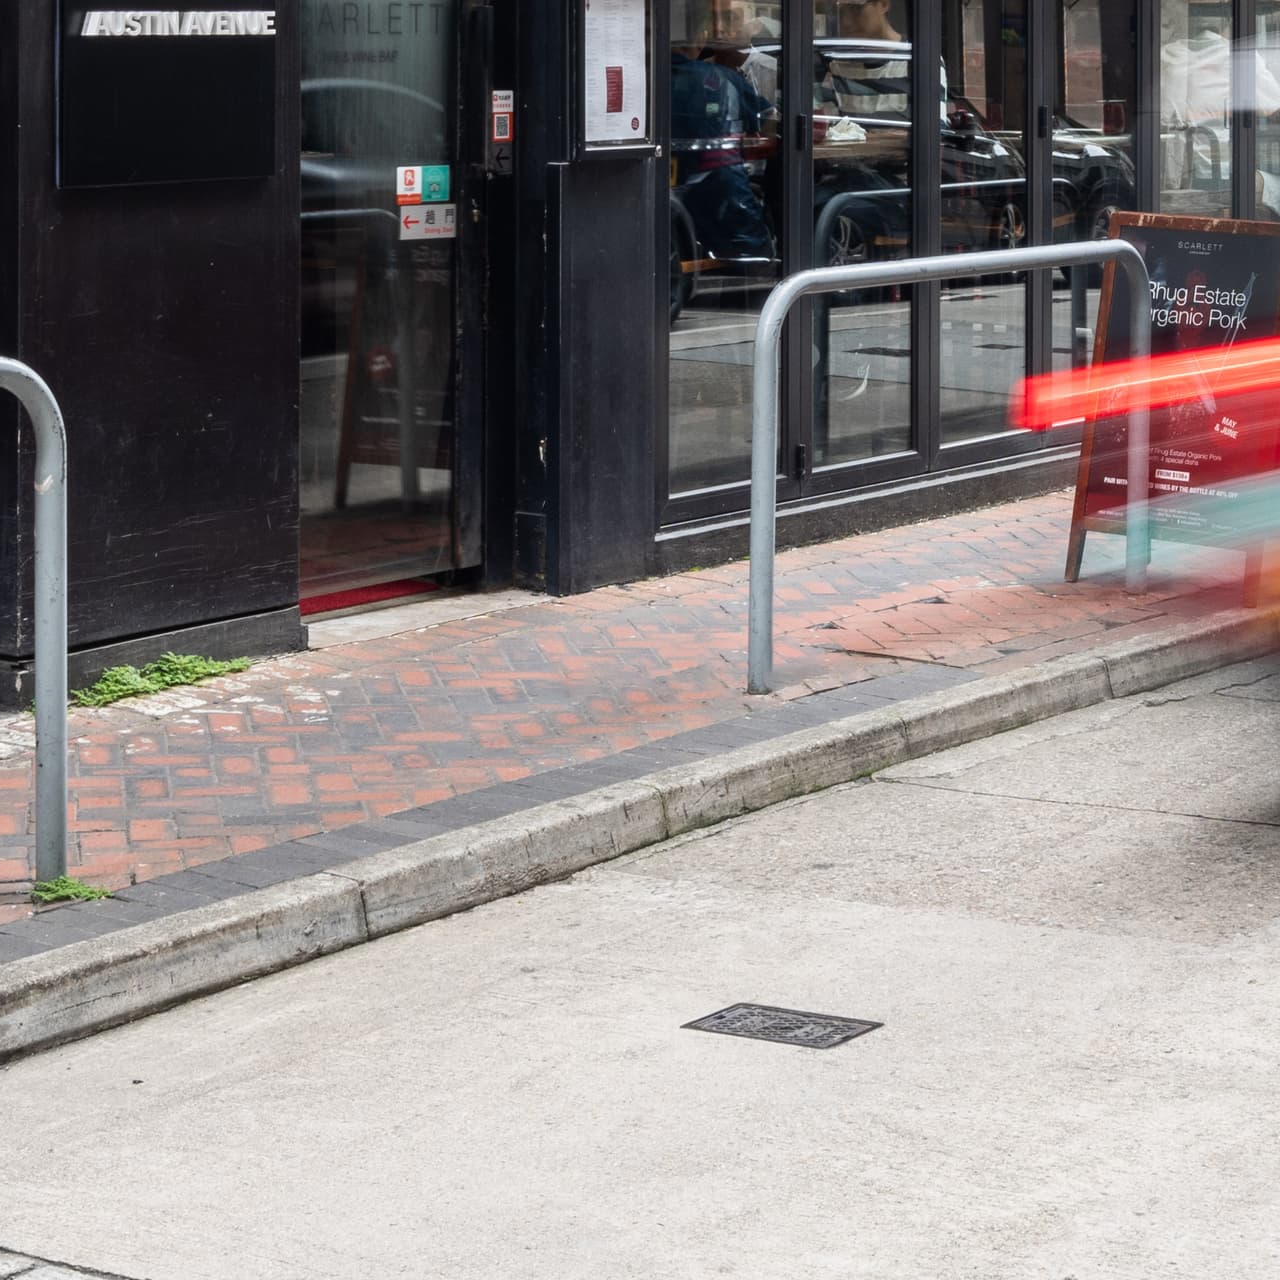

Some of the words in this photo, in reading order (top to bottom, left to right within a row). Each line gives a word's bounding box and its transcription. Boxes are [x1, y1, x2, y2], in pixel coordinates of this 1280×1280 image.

[81, 10, 180, 36] AUSTIN
[180, 10, 276, 35] AVENUE
[302, 1, 445, 35] ARLETT
[1178, 241, 1223, 252] SCARLETT
[1149, 281, 1188, 306] Rhug
[1193, 285, 1247, 307] Estate
[1150, 308, 1203, 327] rganic
[1209, 309, 1247, 330] Pork
[1221, 417, 1237, 428] MAY
[1214, 423, 1220, 432] &
[1221, 426, 1239, 439] JUNE
[1170, 449, 1187, 457] Estate
[1187, 451, 1208, 460] Organic
[1180, 485, 1189, 493] THE
[1190, 486, 1208, 495] BOTTLE
